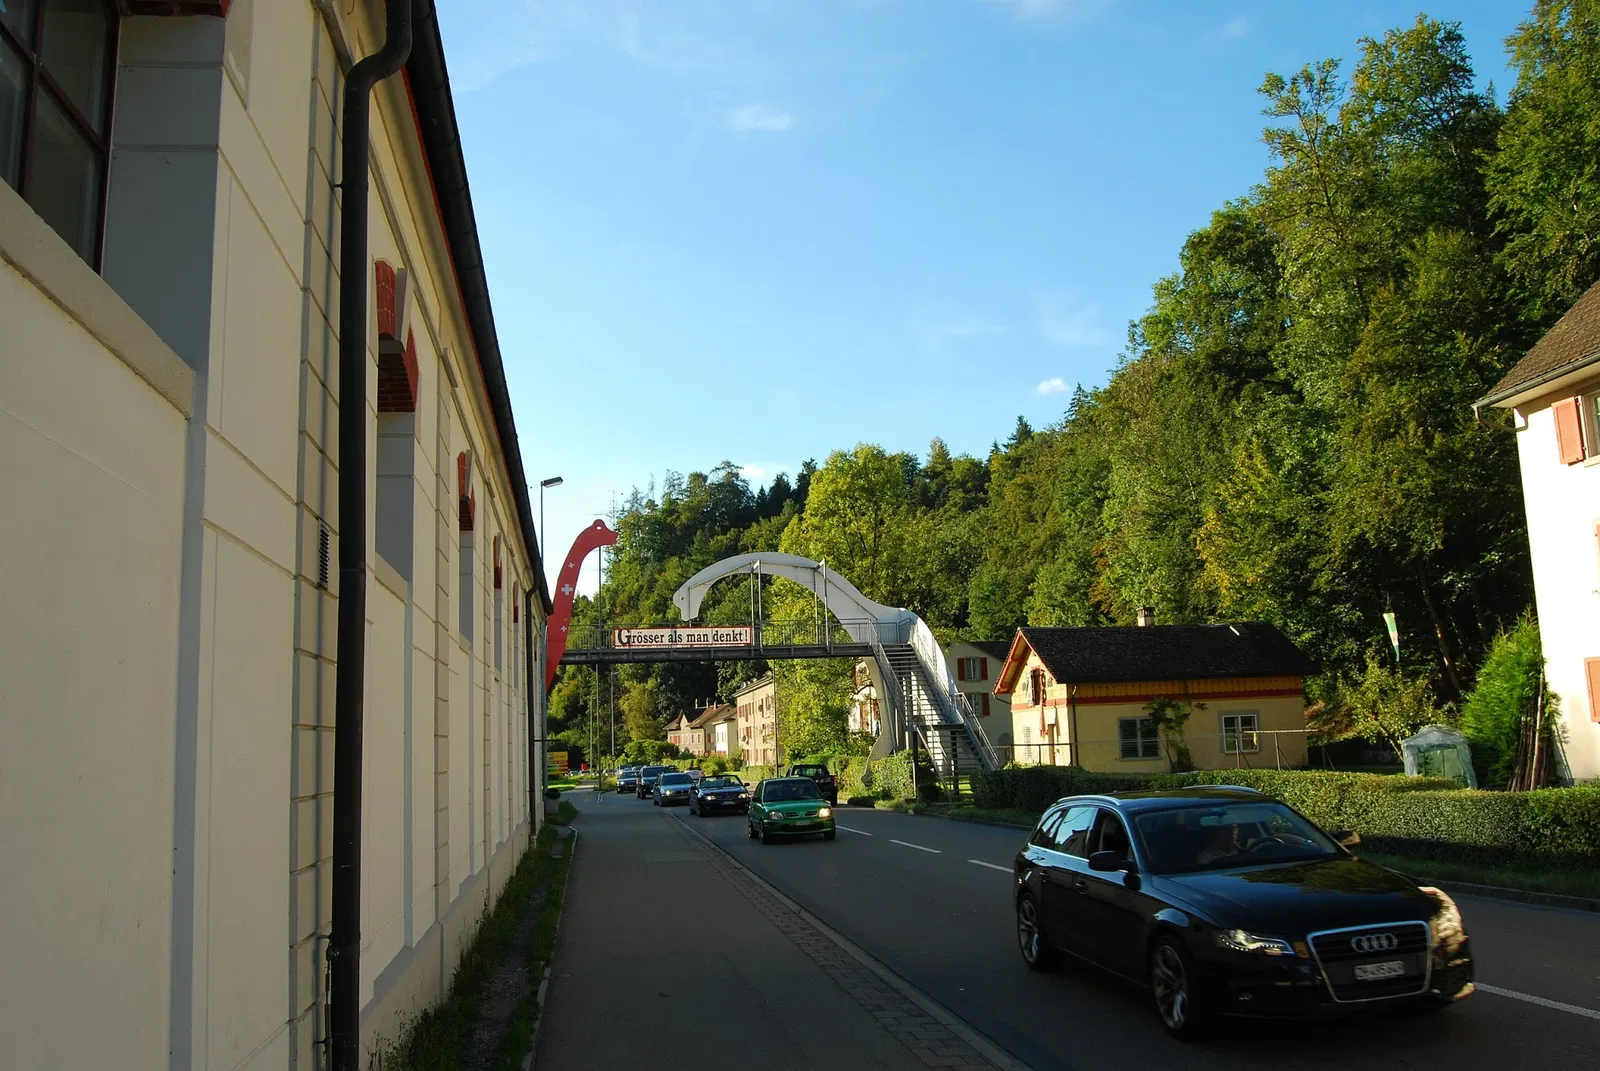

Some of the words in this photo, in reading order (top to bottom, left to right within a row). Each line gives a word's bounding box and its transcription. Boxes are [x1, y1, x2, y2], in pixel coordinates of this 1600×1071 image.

[617, 629, 664, 646] Grösser
[668, 630, 682, 643] als
[686, 633, 709, 643] man
[712, 630, 748, 643] denkt!
